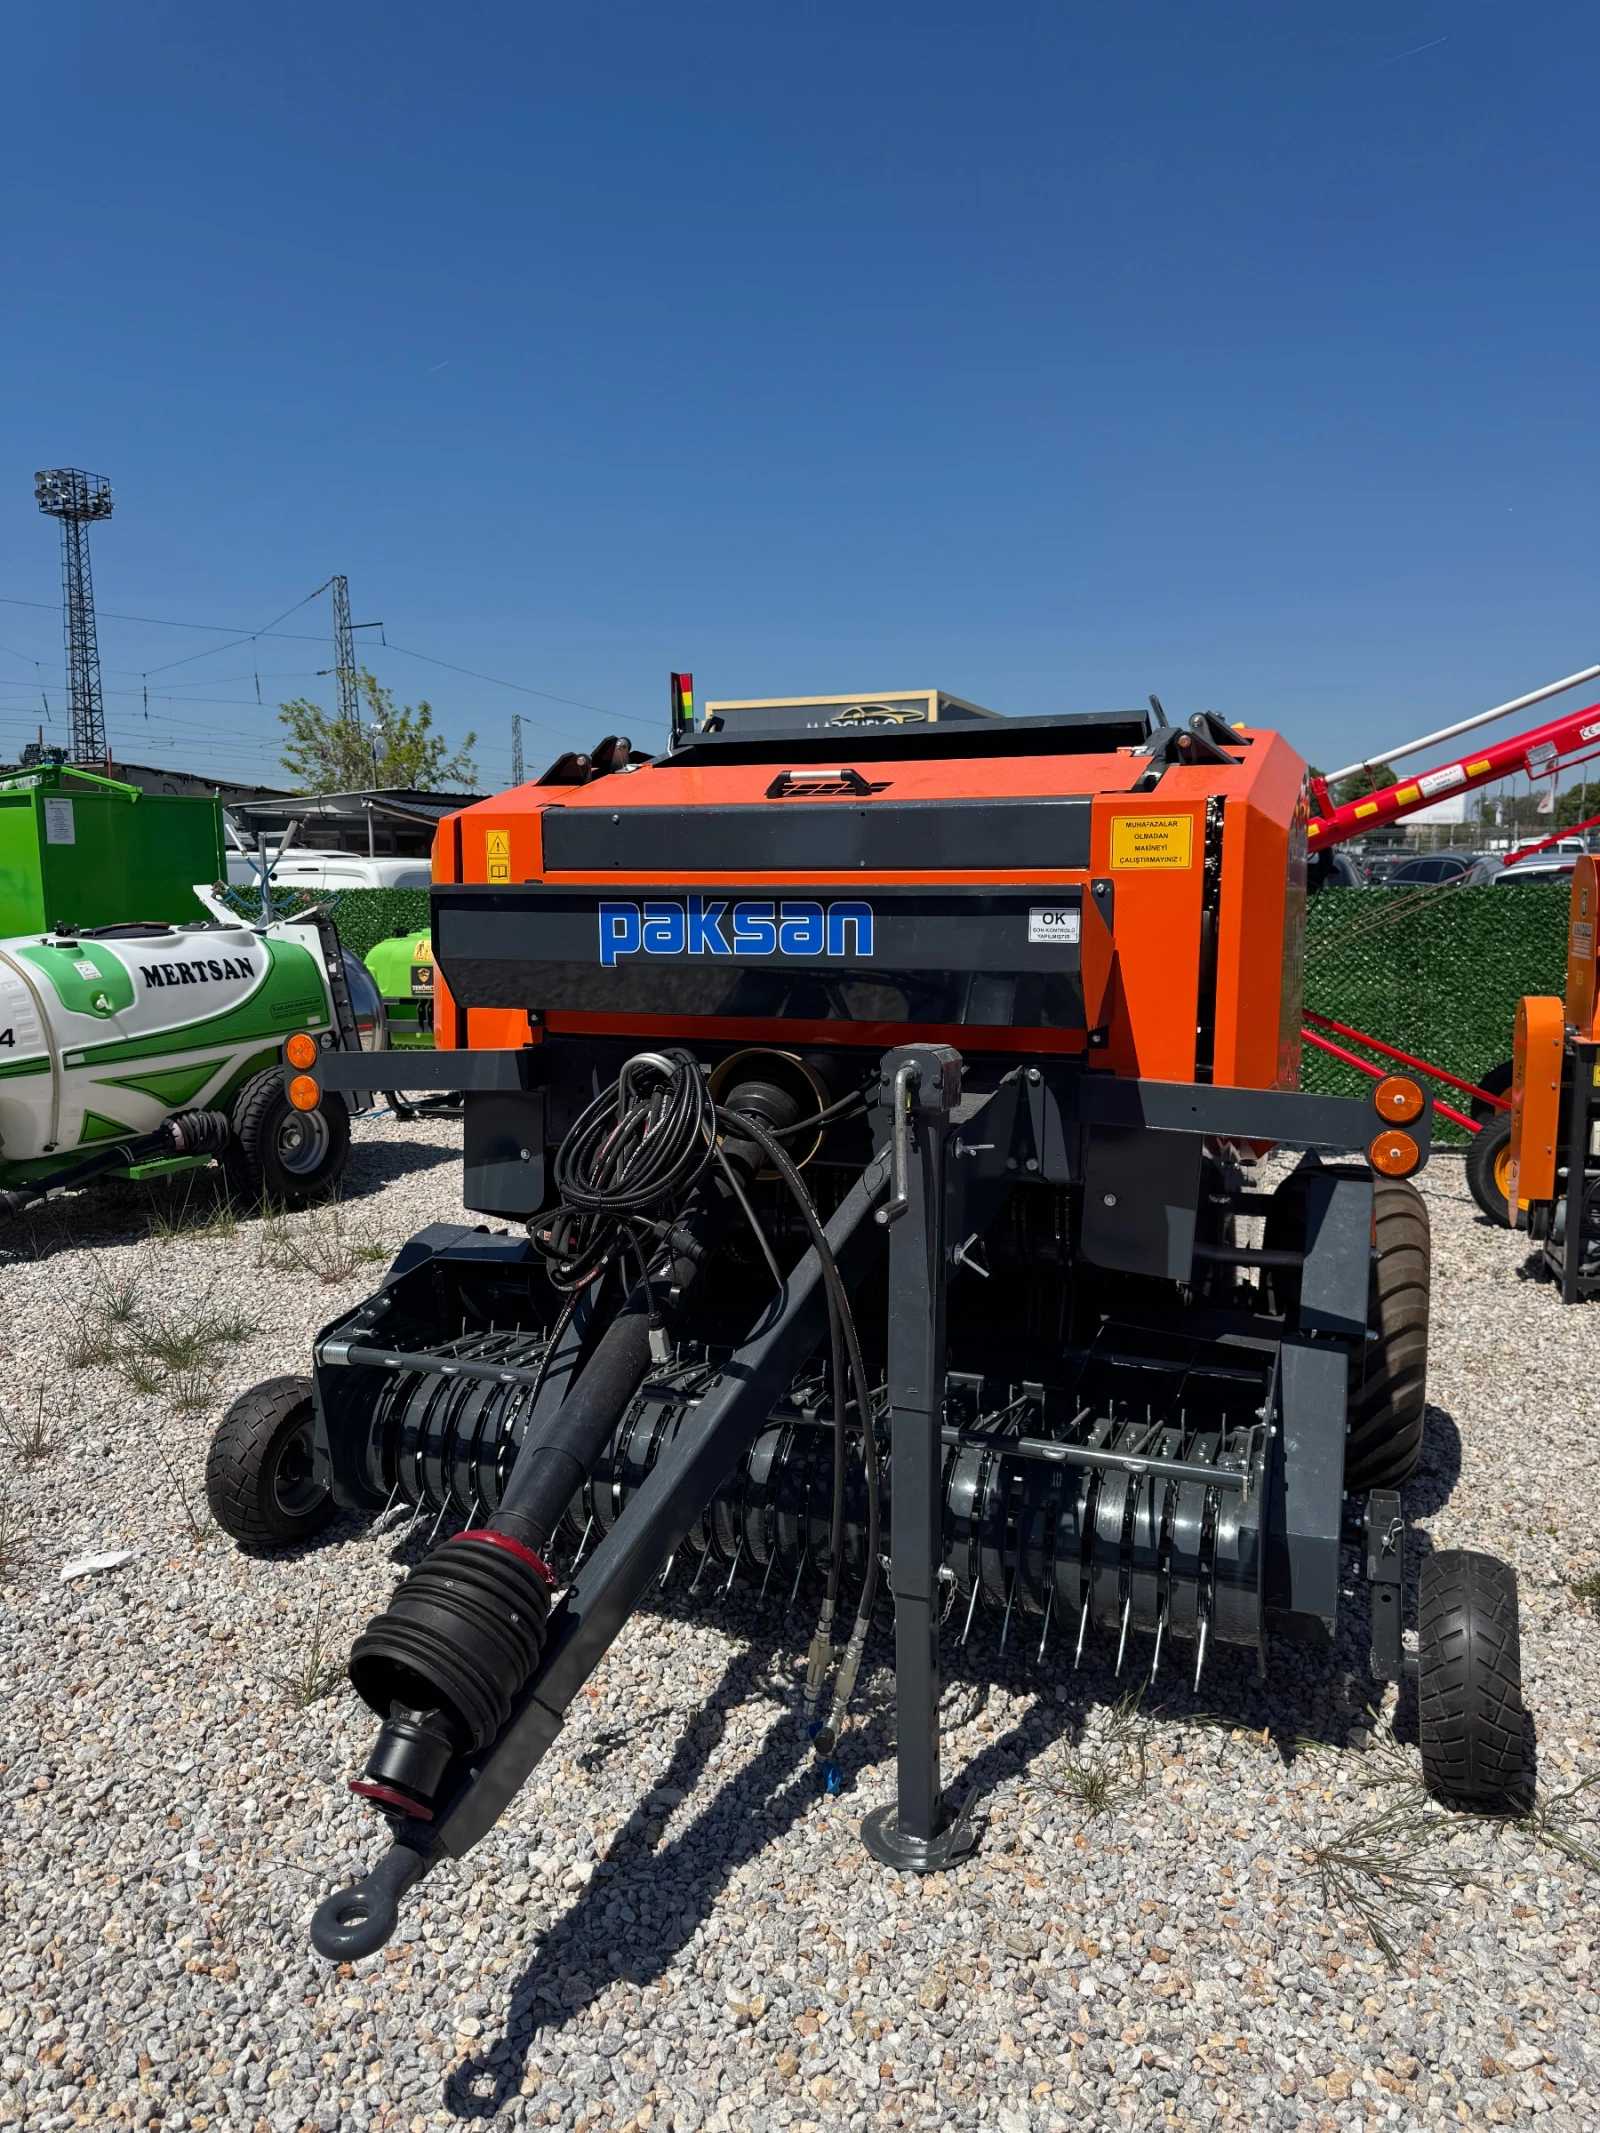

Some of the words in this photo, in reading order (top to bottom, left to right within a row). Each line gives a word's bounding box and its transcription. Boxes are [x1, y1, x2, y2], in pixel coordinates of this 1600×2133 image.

[599, 895, 873, 967] paksan
[1042, 912, 1066, 925] OK
[139, 957, 255, 988] MERTSAN
[0, 1028, 15, 1047] 4
